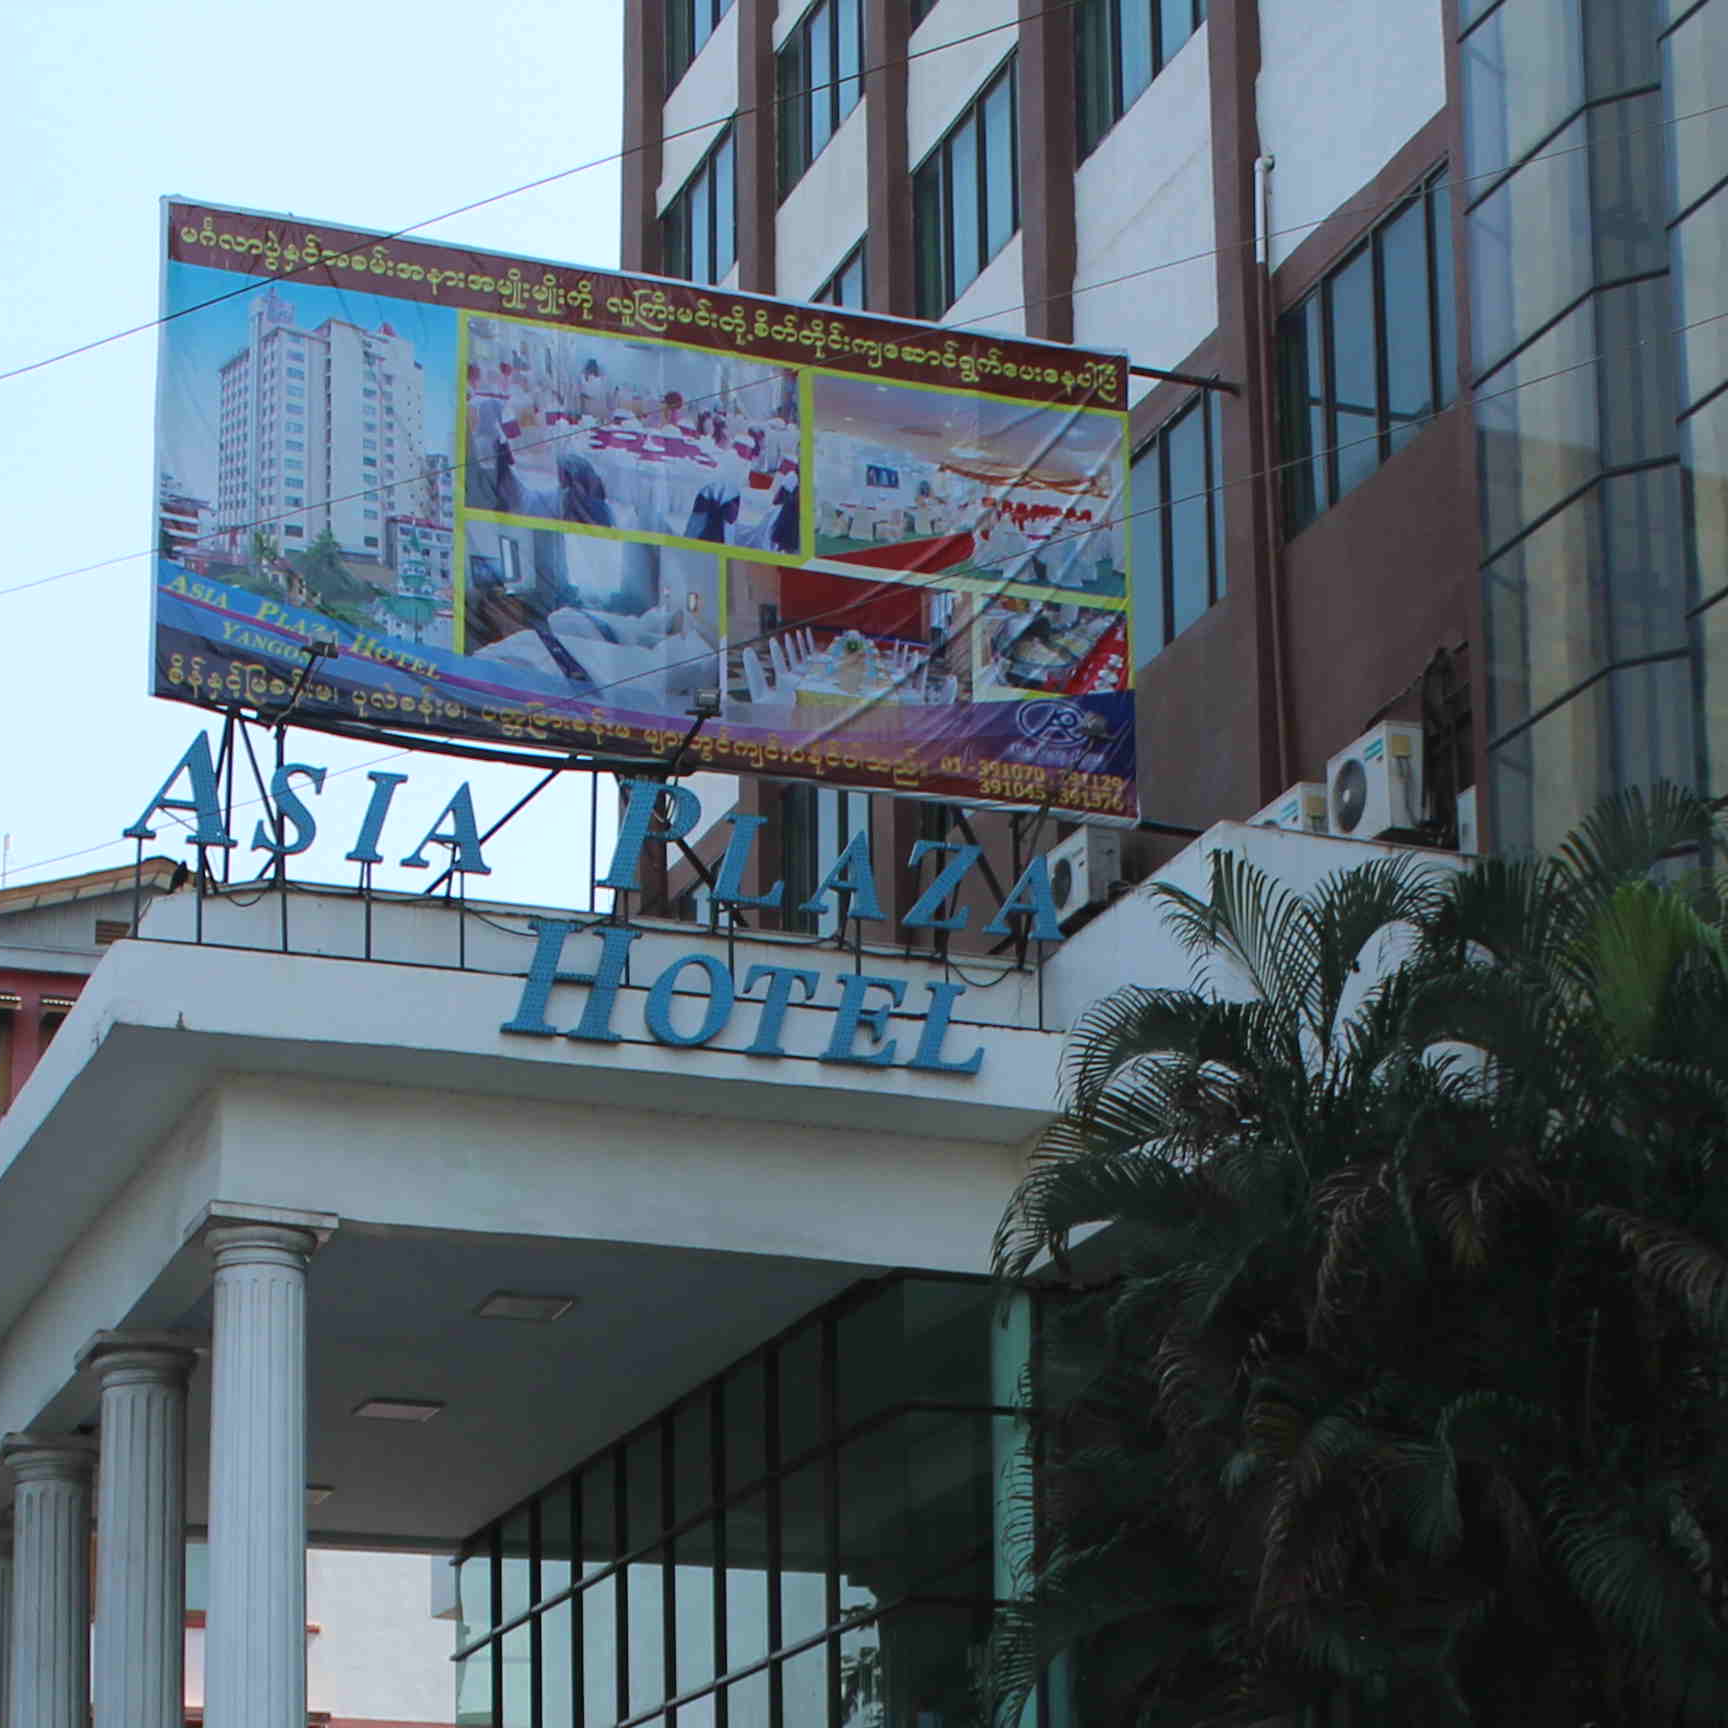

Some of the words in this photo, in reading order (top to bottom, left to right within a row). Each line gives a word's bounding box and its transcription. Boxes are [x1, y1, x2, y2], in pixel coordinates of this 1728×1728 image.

[168, 574, 229, 610] ASIA
[255, 600, 341, 640] PLAZ
[348, 631, 442, 681] HOTEL
[124, 729, 492, 875] ASIA
[595, 774, 1064, 942] PLAZA
[500, 917, 986, 1075] HOTEL
